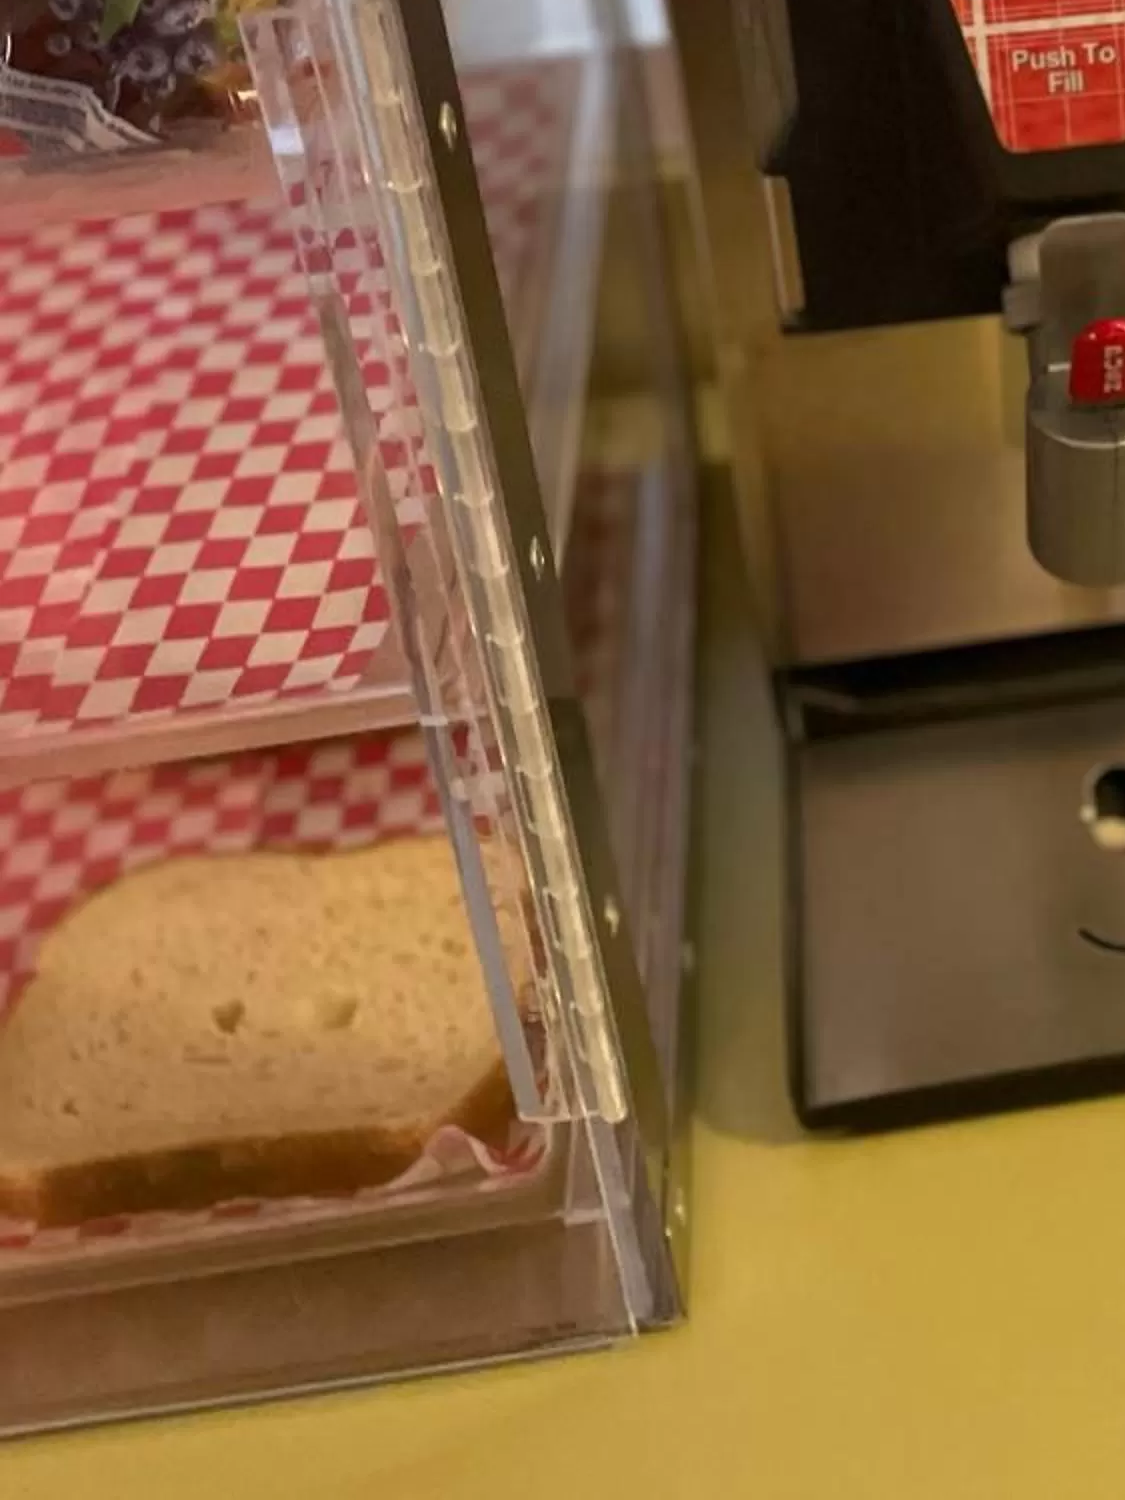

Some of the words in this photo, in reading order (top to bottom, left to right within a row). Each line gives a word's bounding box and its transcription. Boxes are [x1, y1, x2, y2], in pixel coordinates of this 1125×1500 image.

[1012, 46, 1076, 71] Push
[1082, 42, 1116, 64] To
[1048, 70, 1083, 93] Fill
